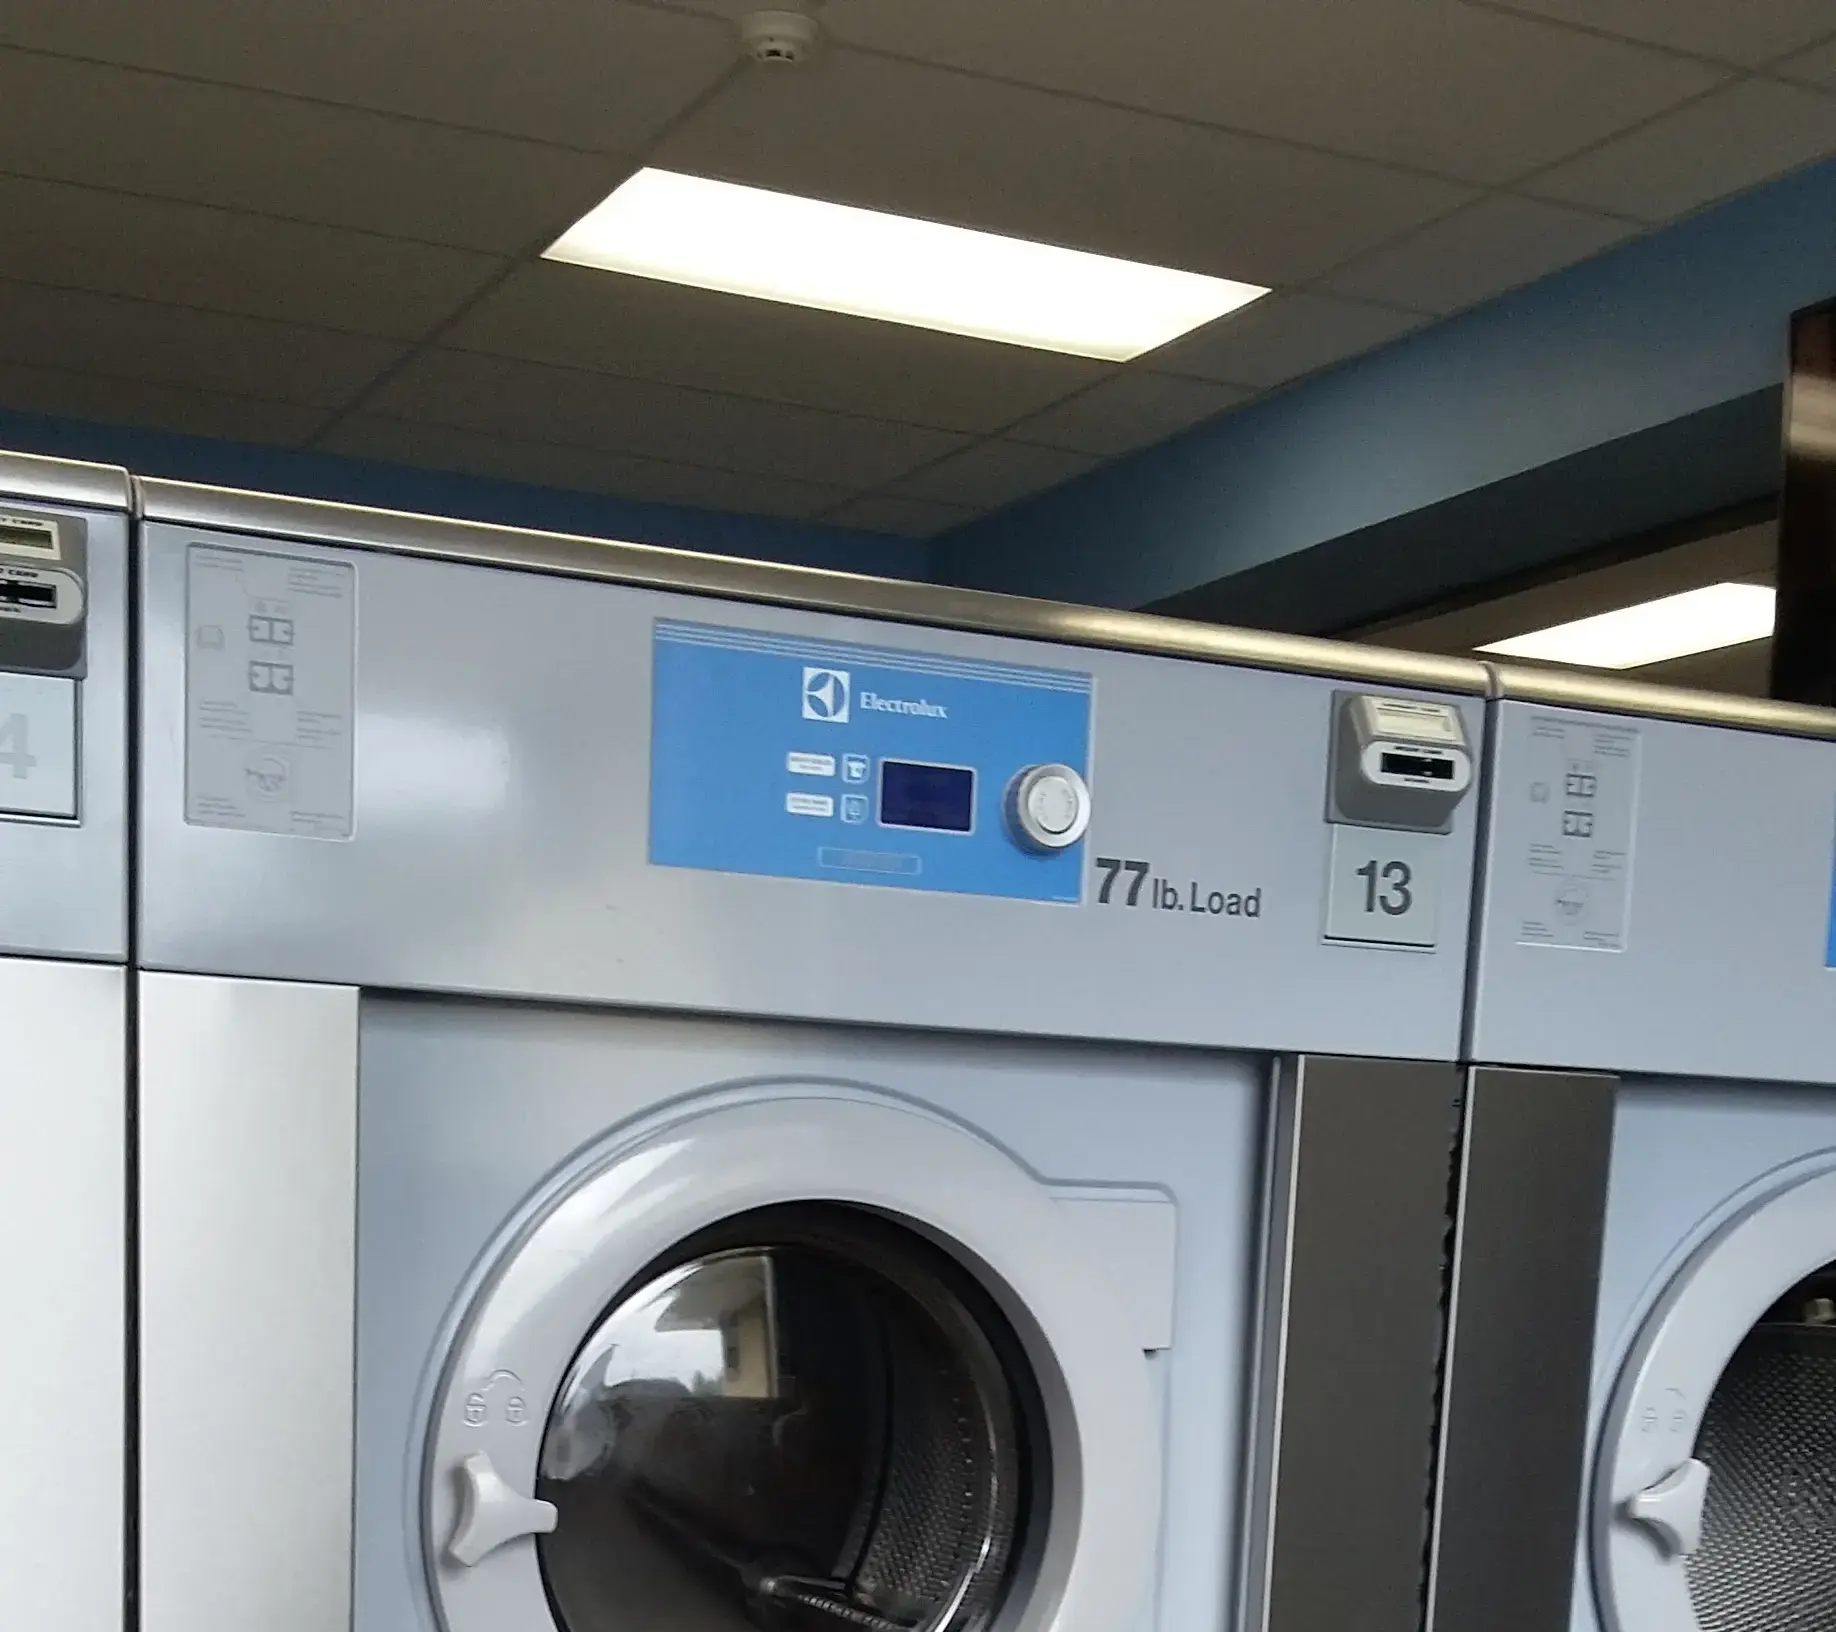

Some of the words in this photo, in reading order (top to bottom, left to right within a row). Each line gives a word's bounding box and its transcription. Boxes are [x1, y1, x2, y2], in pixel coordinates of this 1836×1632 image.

[859, 691, 949, 720] Electrolux
[1096, 857, 1149, 906] 77
[1356, 859, 1413, 916] 13
